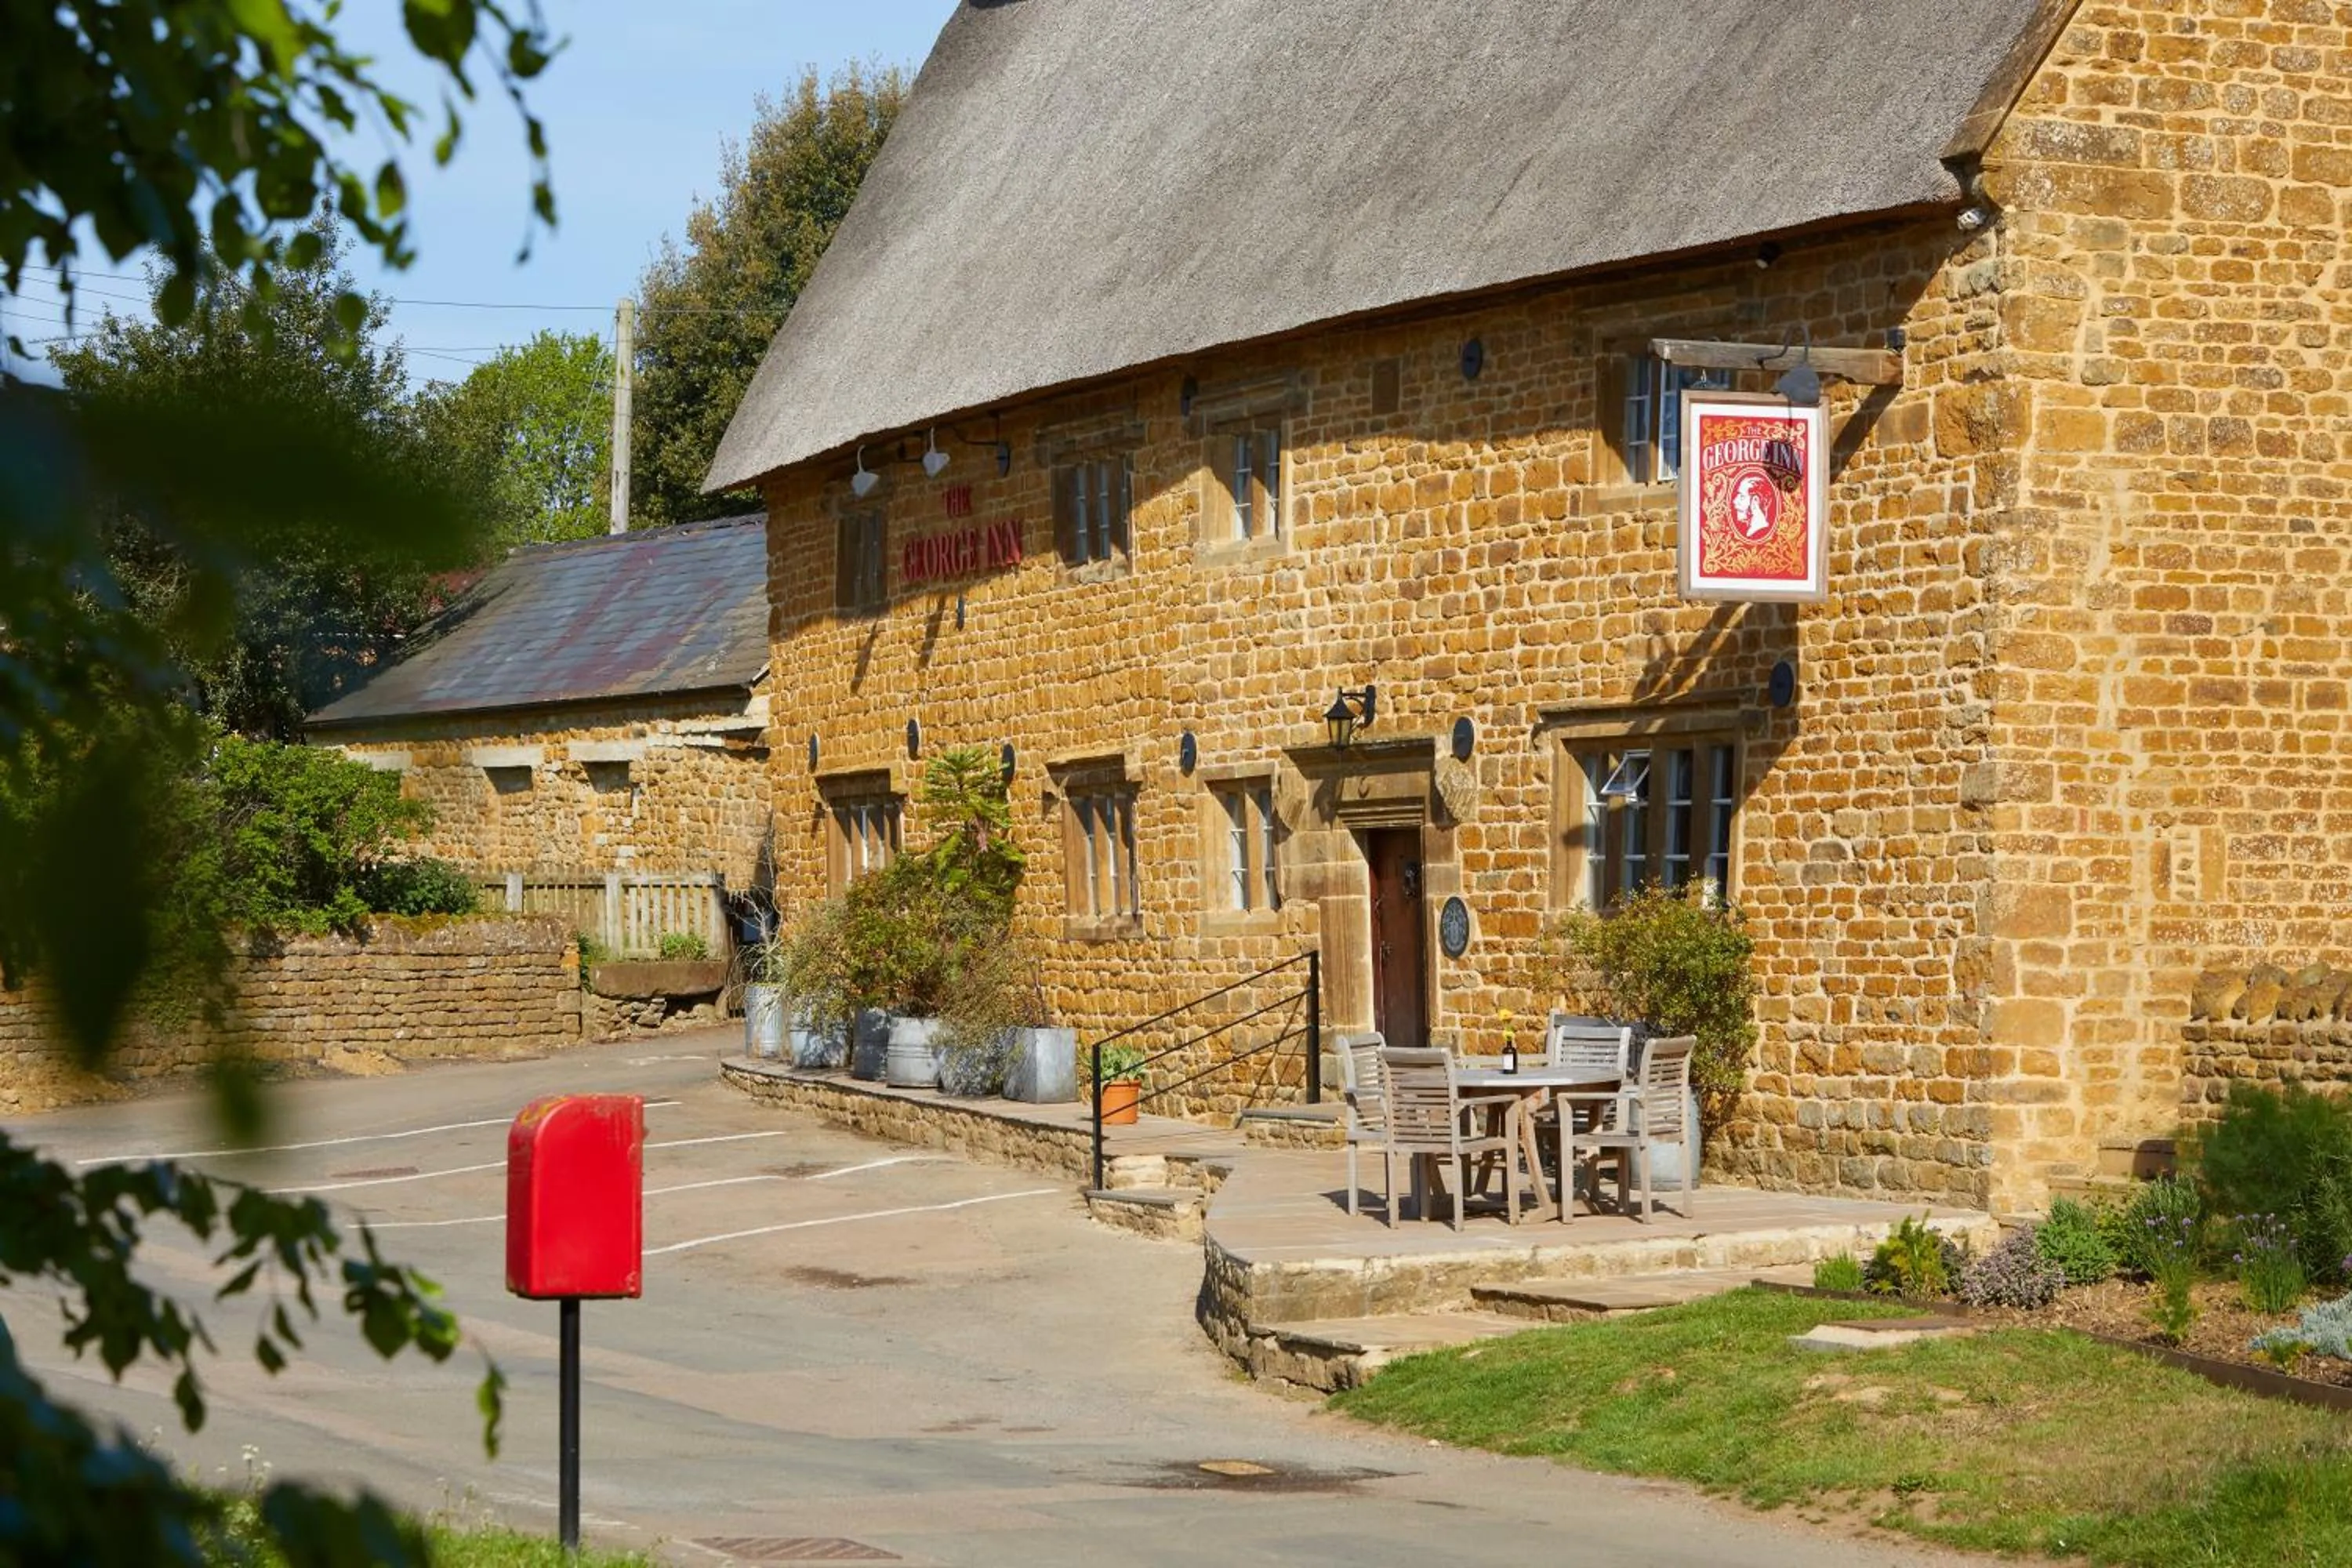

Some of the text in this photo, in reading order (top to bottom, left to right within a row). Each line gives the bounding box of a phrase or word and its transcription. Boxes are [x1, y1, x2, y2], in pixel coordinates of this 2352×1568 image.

[1747, 426, 1762, 435] THE
[1703, 439, 1803, 475] GEORGE INN
[944, 484, 971, 517] THE
[902, 519, 1022, 581] GEORGE INN
